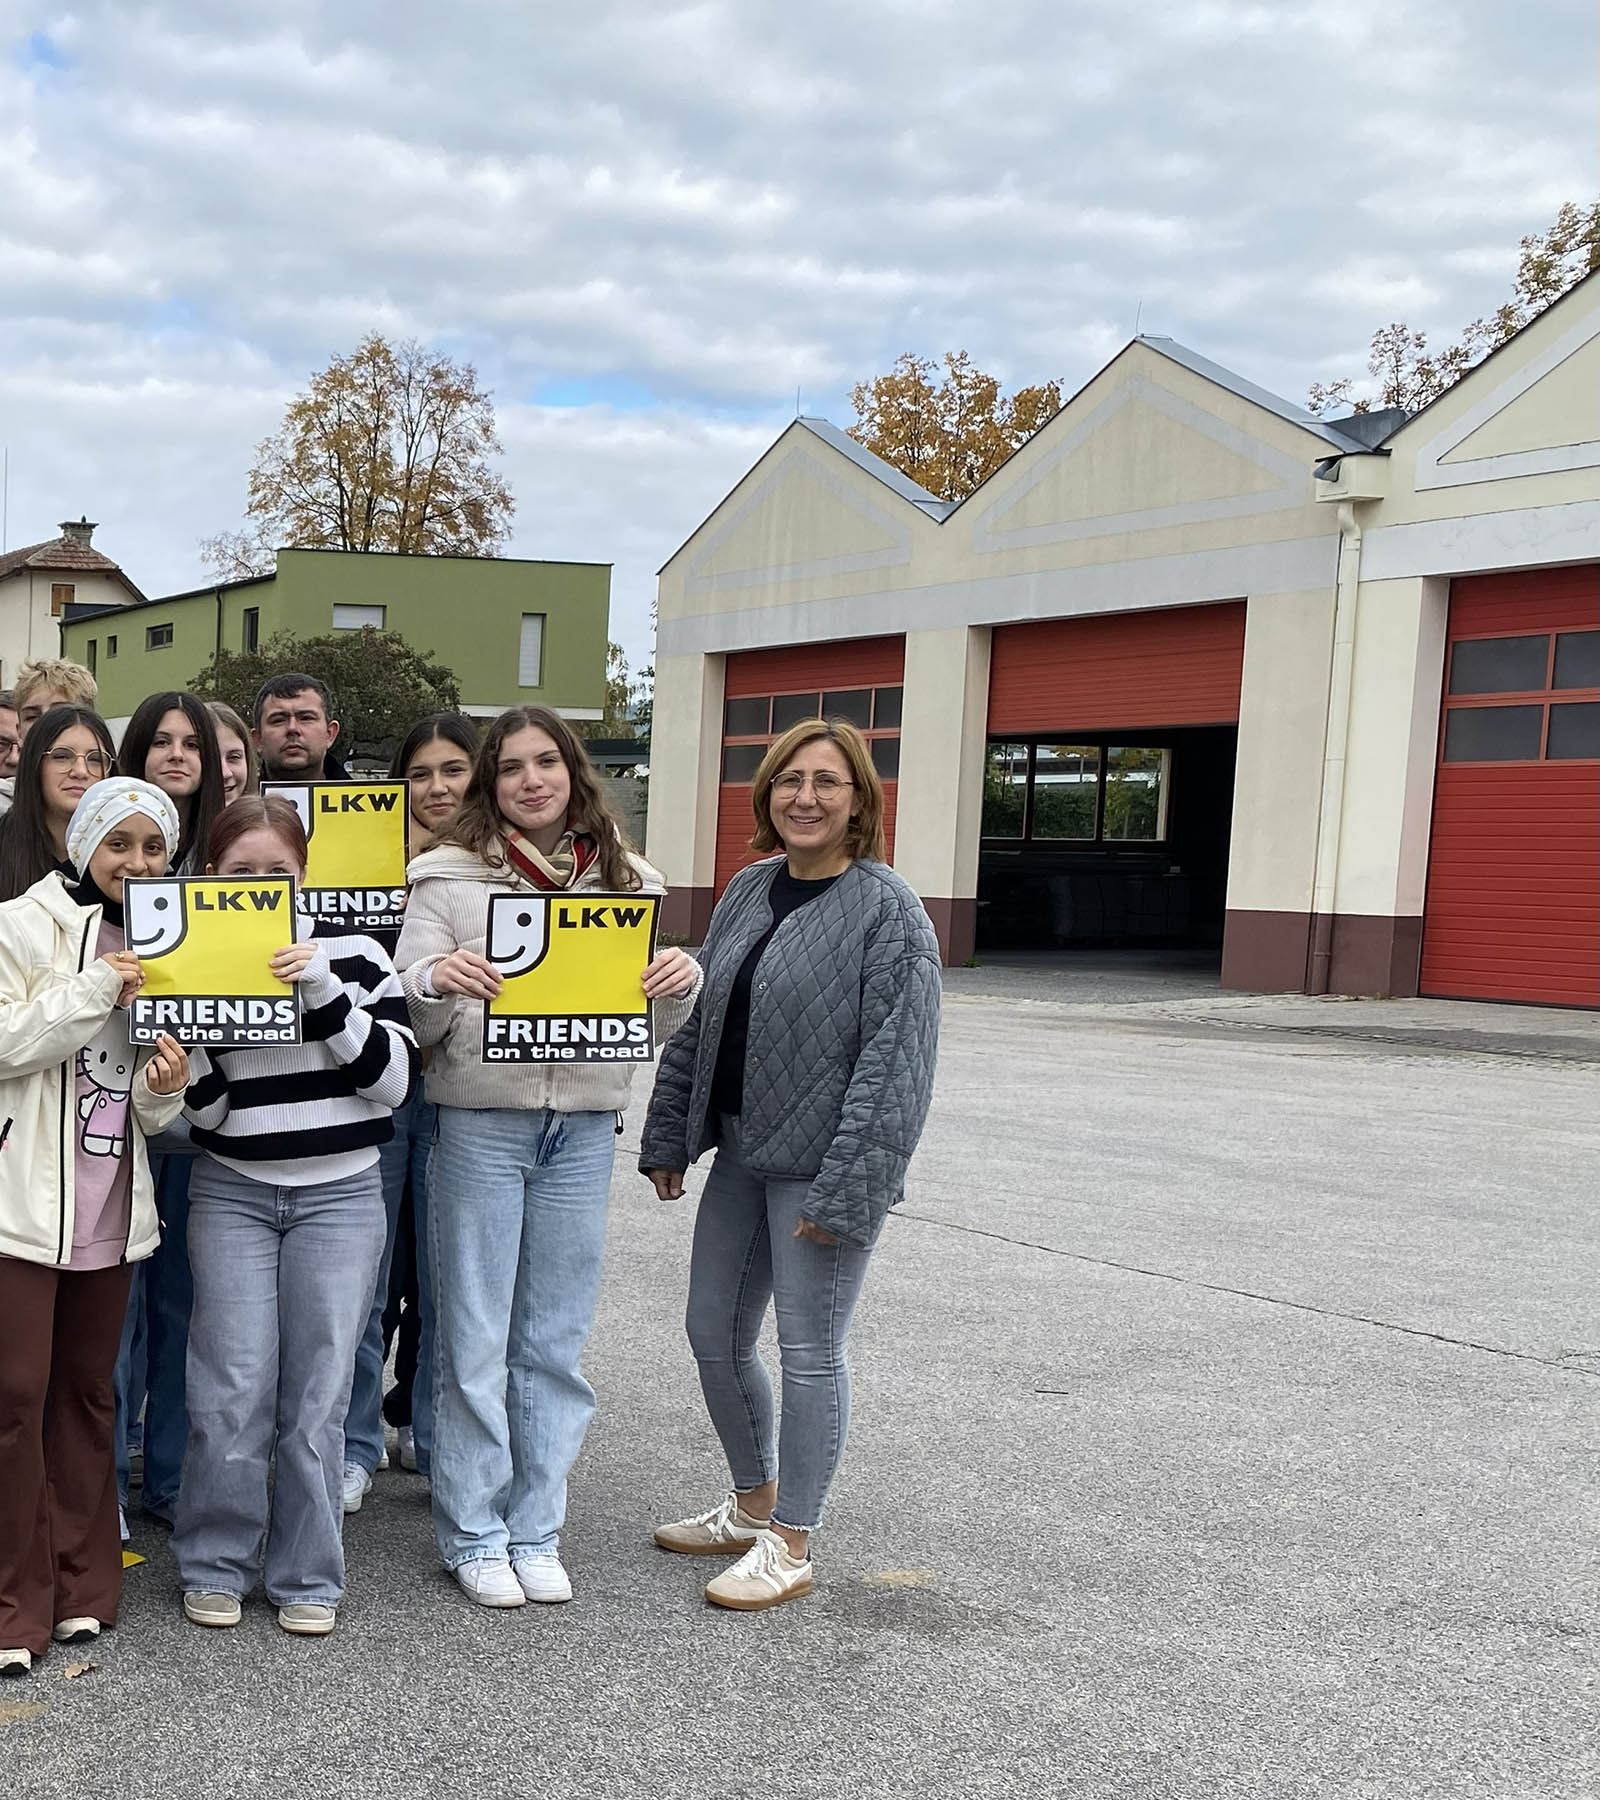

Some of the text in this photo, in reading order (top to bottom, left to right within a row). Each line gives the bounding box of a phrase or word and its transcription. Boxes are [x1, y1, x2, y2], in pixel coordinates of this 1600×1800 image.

[321, 793, 399, 813] LKW
[194, 890, 283, 911] LKW
[296, 889, 407, 913] RIENDS
[313, 914, 345, 926] he
[558, 907, 648, 928] LKW
[135, 999, 296, 1025] FRIENDS
[135, 1025, 296, 1041] on the road
[487, 1018, 649, 1043] FRIENDS
[487, 1043, 649, 1059] on the road
